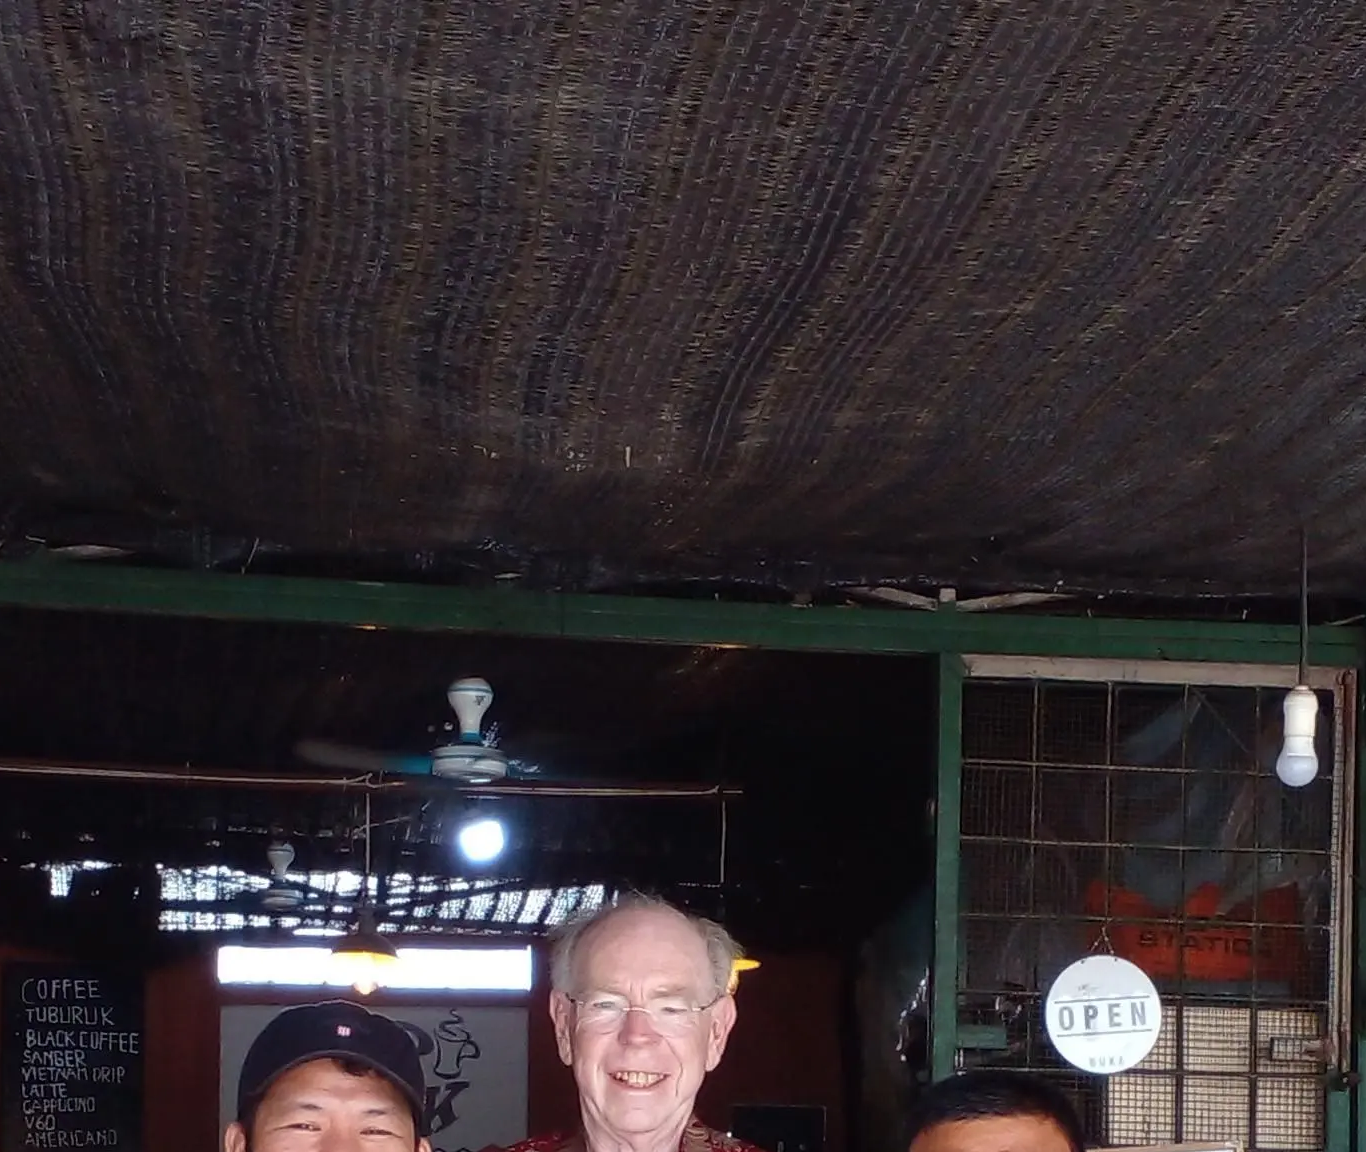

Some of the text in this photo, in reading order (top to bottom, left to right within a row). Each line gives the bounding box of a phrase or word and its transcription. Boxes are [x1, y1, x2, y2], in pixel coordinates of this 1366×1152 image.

[21, 978, 101, 1005] COFFEE
[25, 1005, 115, 1026] TUBURUK
[1058, 1001, 1147, 1031] OPEN
[26, 1030, 139, 1054] BLACK COFFEE
[23, 1049, 87, 1068] SANGER
[21, 1066, 125, 1083] VIETNAM DRIP
[21, 1083, 68, 1098] LATTE
[22, 1096, 96, 1115] CAPPUCINO
[25, 1114, 56, 1131] V60
[25, 1129, 117, 1147] AMERICANO
